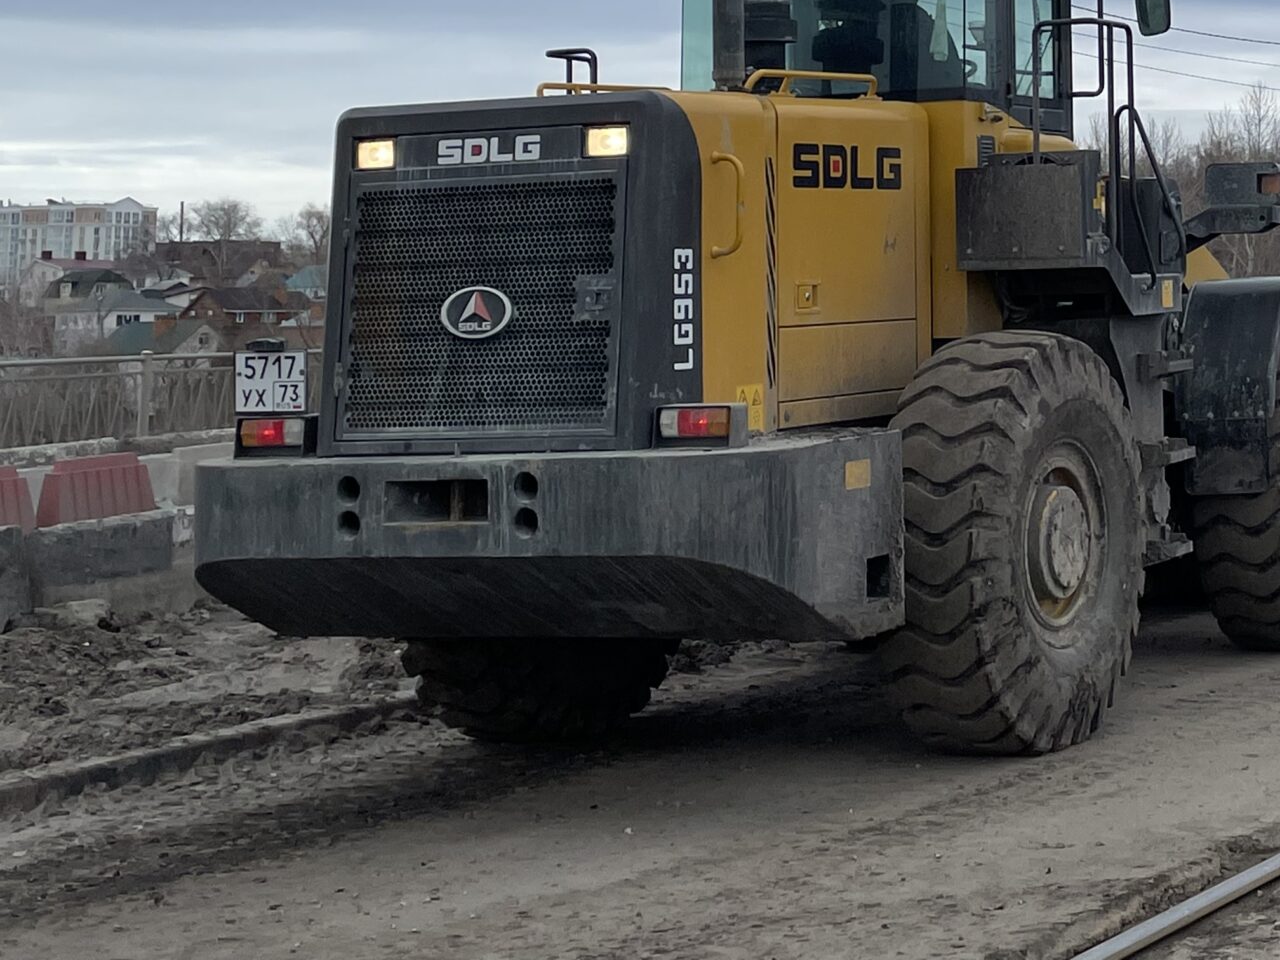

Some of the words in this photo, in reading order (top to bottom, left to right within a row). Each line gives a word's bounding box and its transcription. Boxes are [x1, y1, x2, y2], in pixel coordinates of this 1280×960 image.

[438, 135, 541, 165] SDLG
[793, 143, 902, 190] SDLG
[673, 248, 694, 371] LG953
[458, 321, 492, 332] SDLG
[244, 355, 296, 379] 5717
[279, 384, 299, 403] 73
